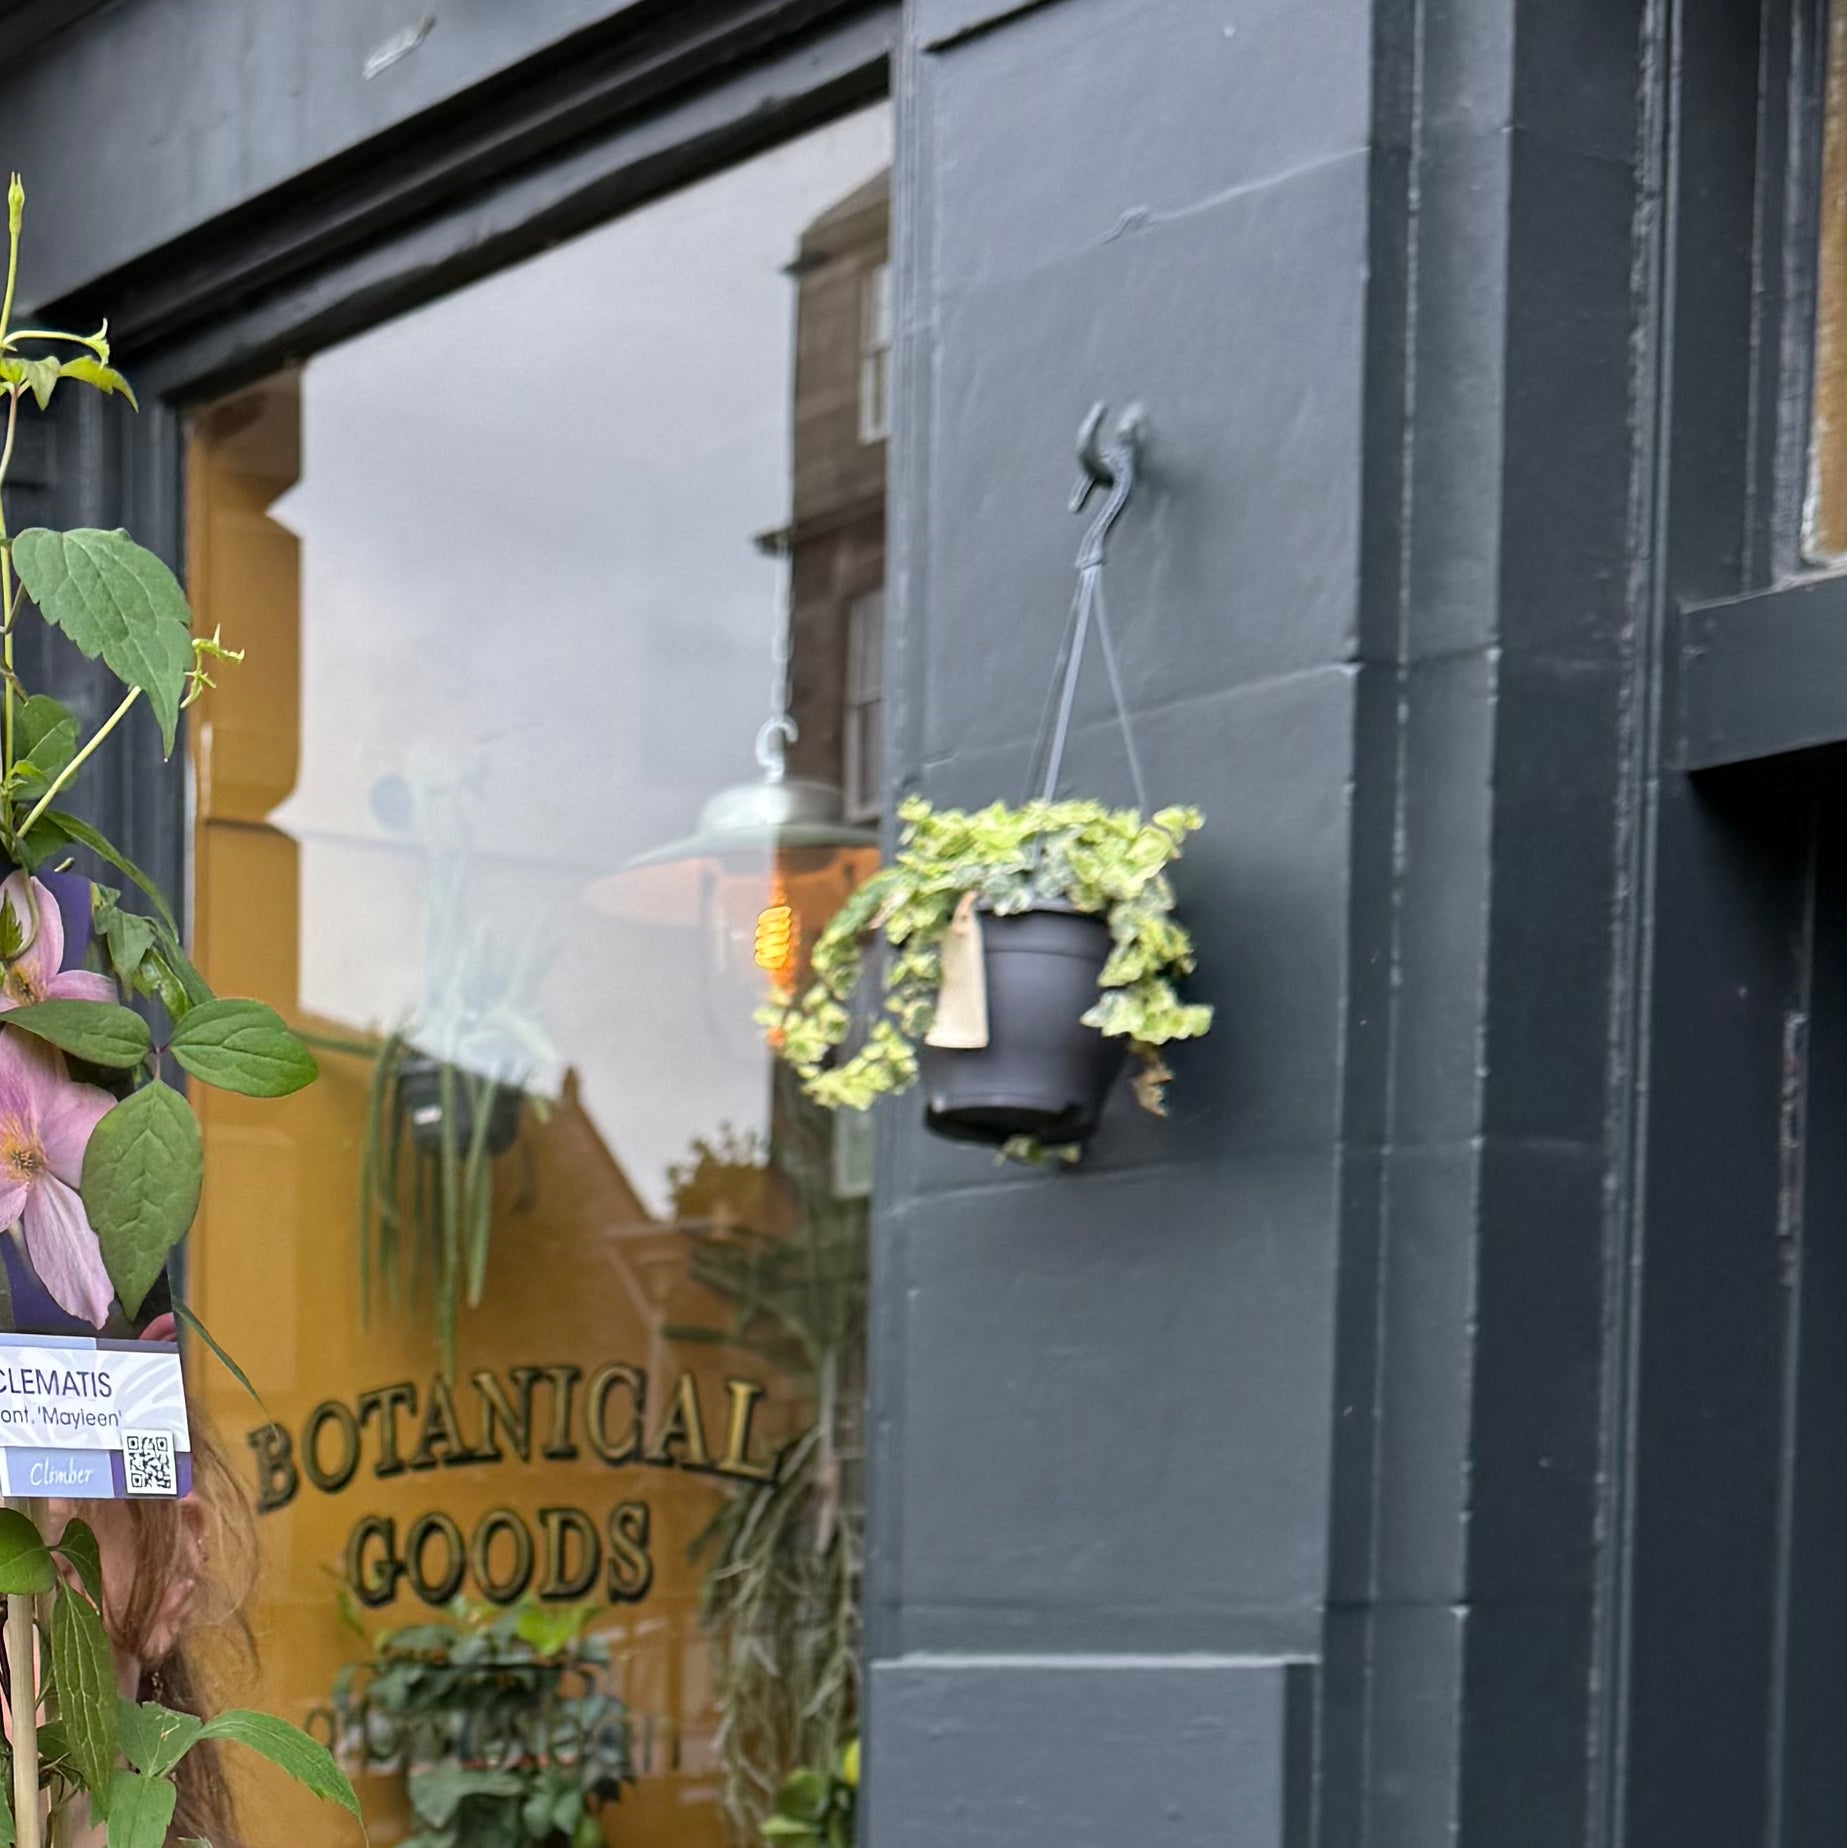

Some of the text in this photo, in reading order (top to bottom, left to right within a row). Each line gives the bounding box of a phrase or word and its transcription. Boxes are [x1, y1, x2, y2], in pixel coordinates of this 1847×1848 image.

[30, 1457, 94, 1486] Climber
[248, 1362, 779, 1515] BOTANICAL
[344, 1502, 654, 1607] GOODS
